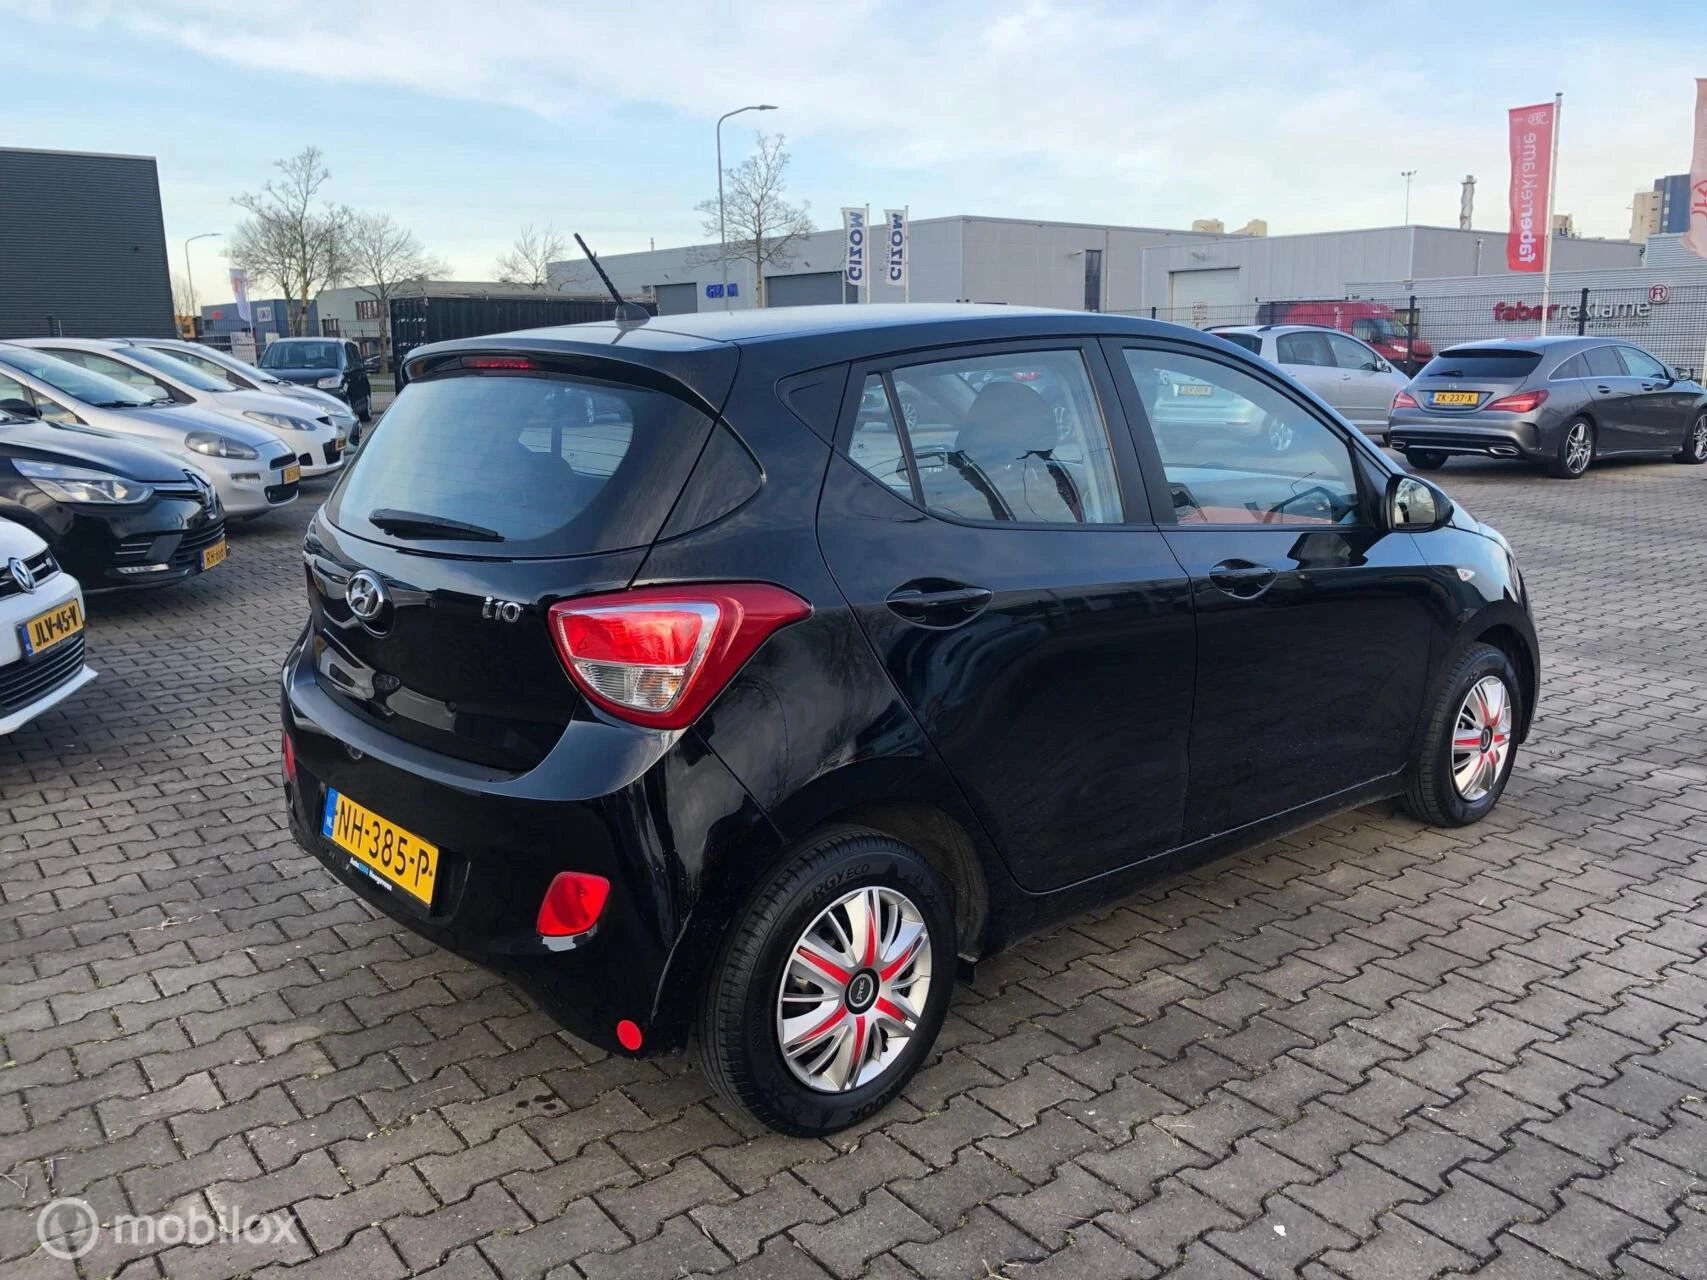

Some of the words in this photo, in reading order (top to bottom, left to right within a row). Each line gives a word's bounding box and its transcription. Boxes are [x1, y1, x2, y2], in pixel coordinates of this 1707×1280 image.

[1436, 394, 1472, 402] ZK-237-X
[482, 596, 521, 623] i10
[337, 800, 430, 887] NH-385-P
